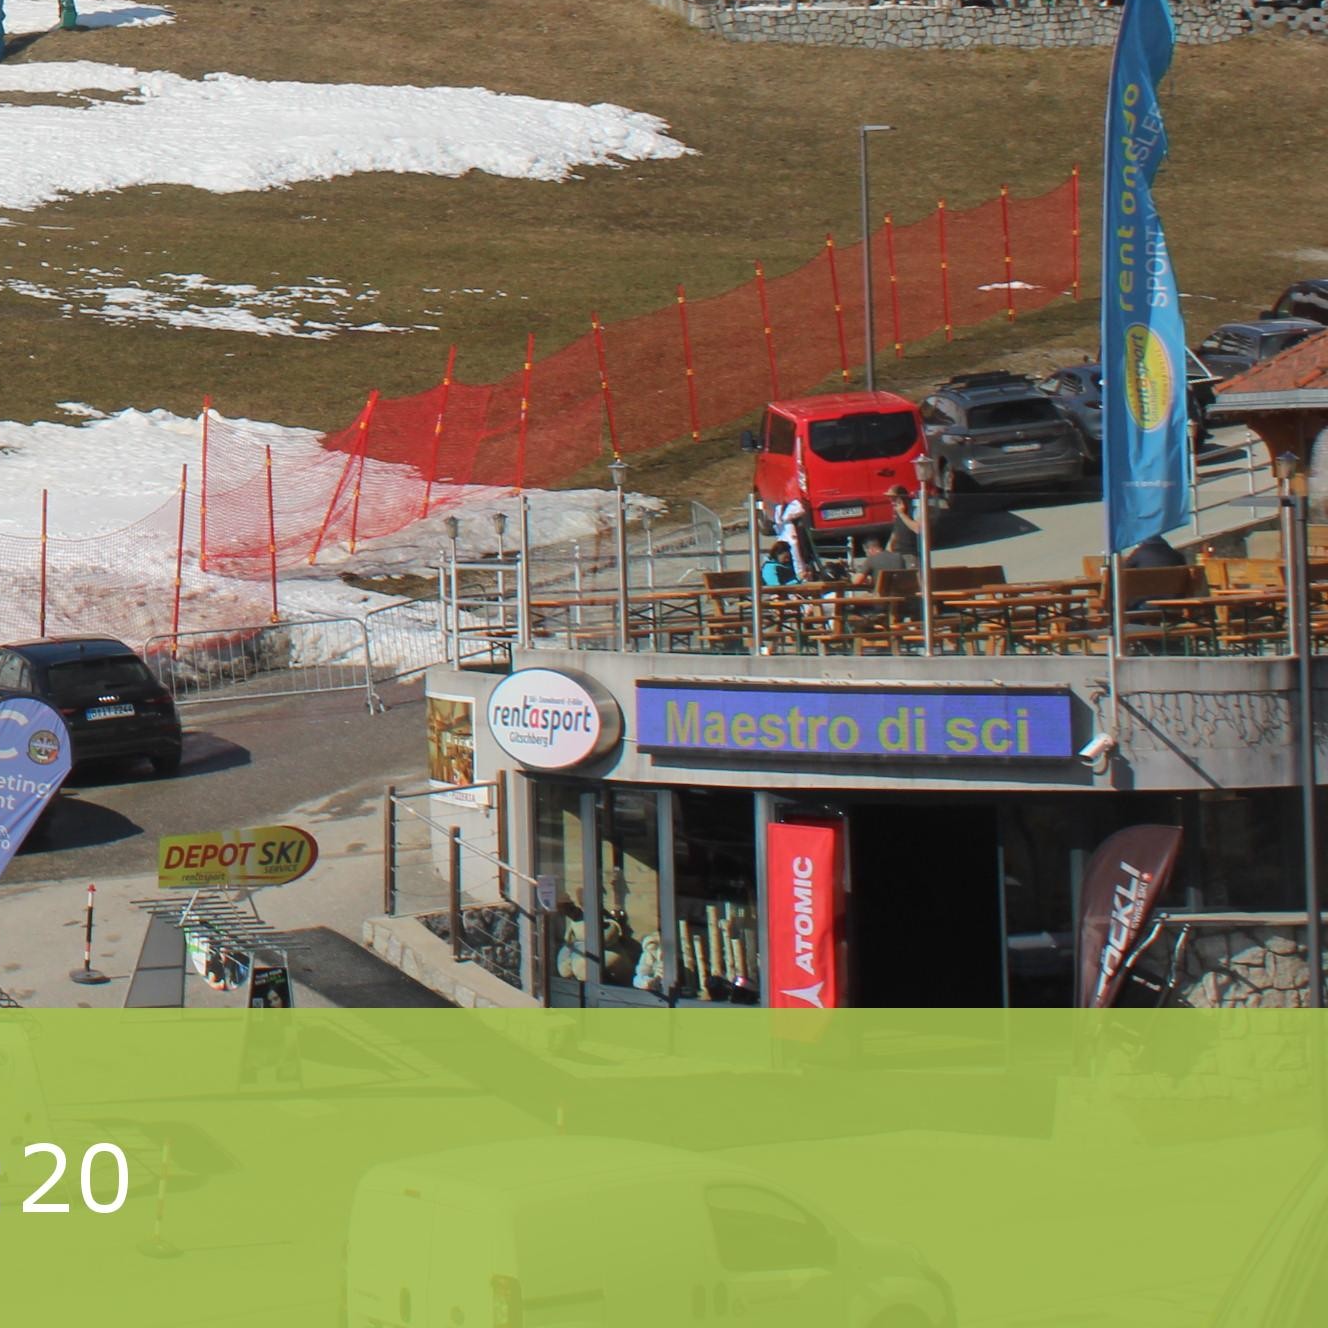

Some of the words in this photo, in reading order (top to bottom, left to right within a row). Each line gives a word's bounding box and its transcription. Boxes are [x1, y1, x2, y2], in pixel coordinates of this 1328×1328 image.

[1117, 225, 1135, 311] rent
[1144, 225, 1169, 309] SPORT
[493, 695, 592, 746] rentasport
[666, 700, 860, 751] Maestro
[877, 706, 926, 753] di
[945, 708, 1031, 754] sci
[164, 842, 257, 869] DEPOT
[258, 840, 305, 866] SKI
[792, 856, 815, 976] ATOMIC
